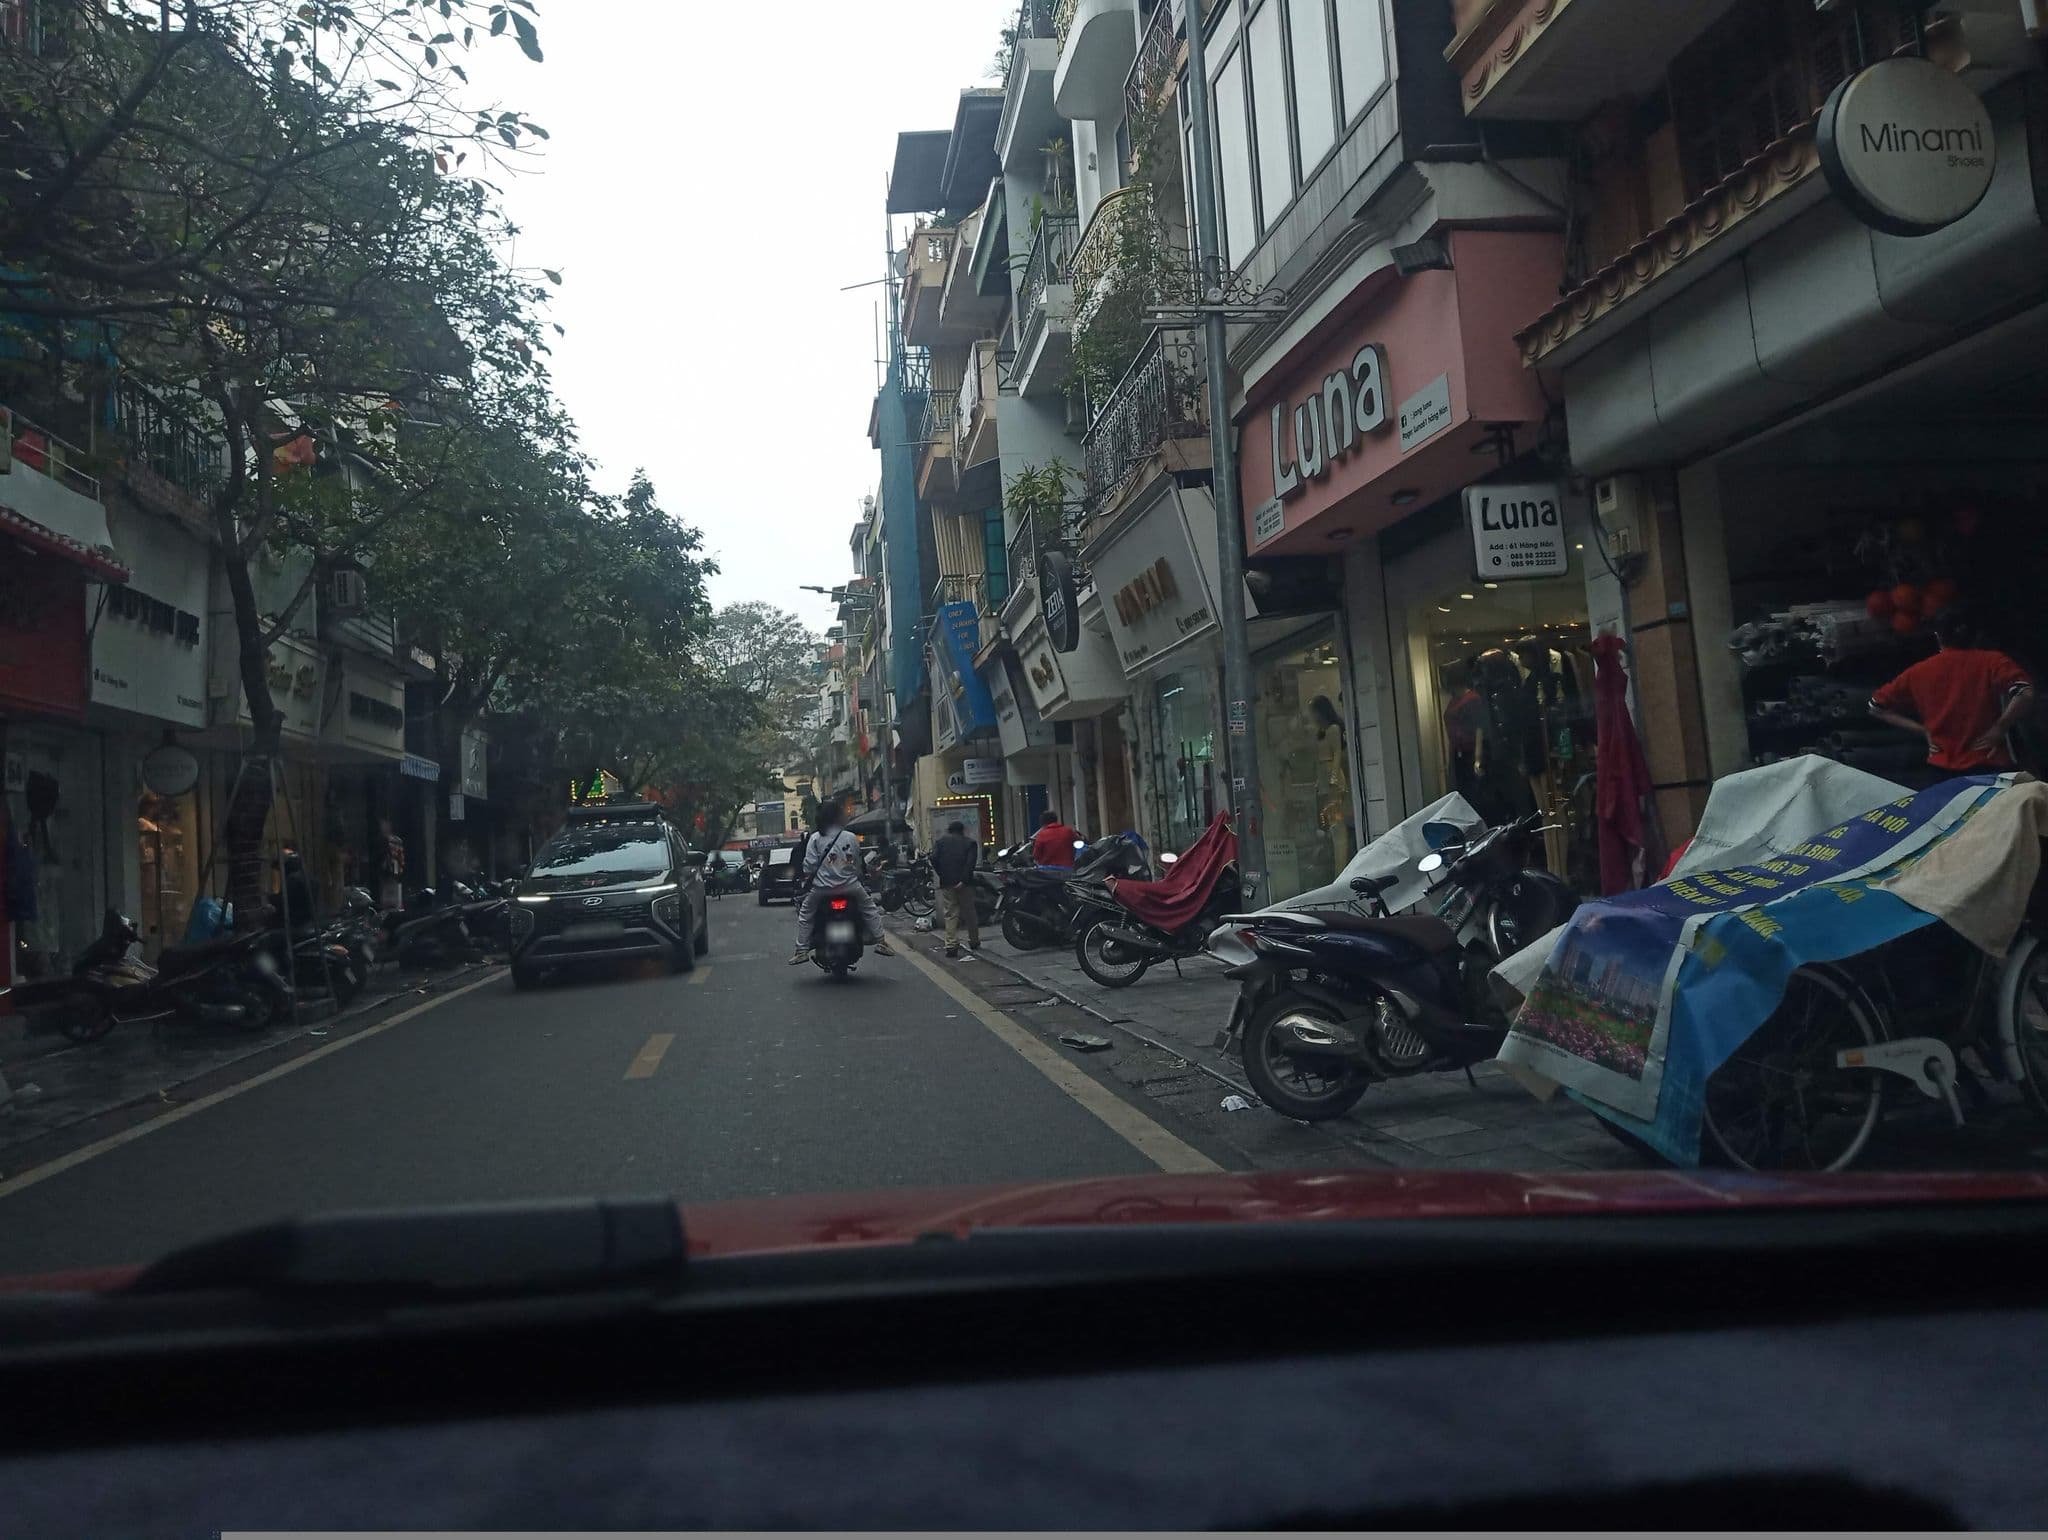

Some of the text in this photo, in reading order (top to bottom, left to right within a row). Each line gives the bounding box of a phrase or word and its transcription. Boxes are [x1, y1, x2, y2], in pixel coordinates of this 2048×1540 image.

[1859, 121, 1983, 153] Minami
[1271, 343, 1388, 500] Luna
[1481, 497, 1558, 531] Luna
